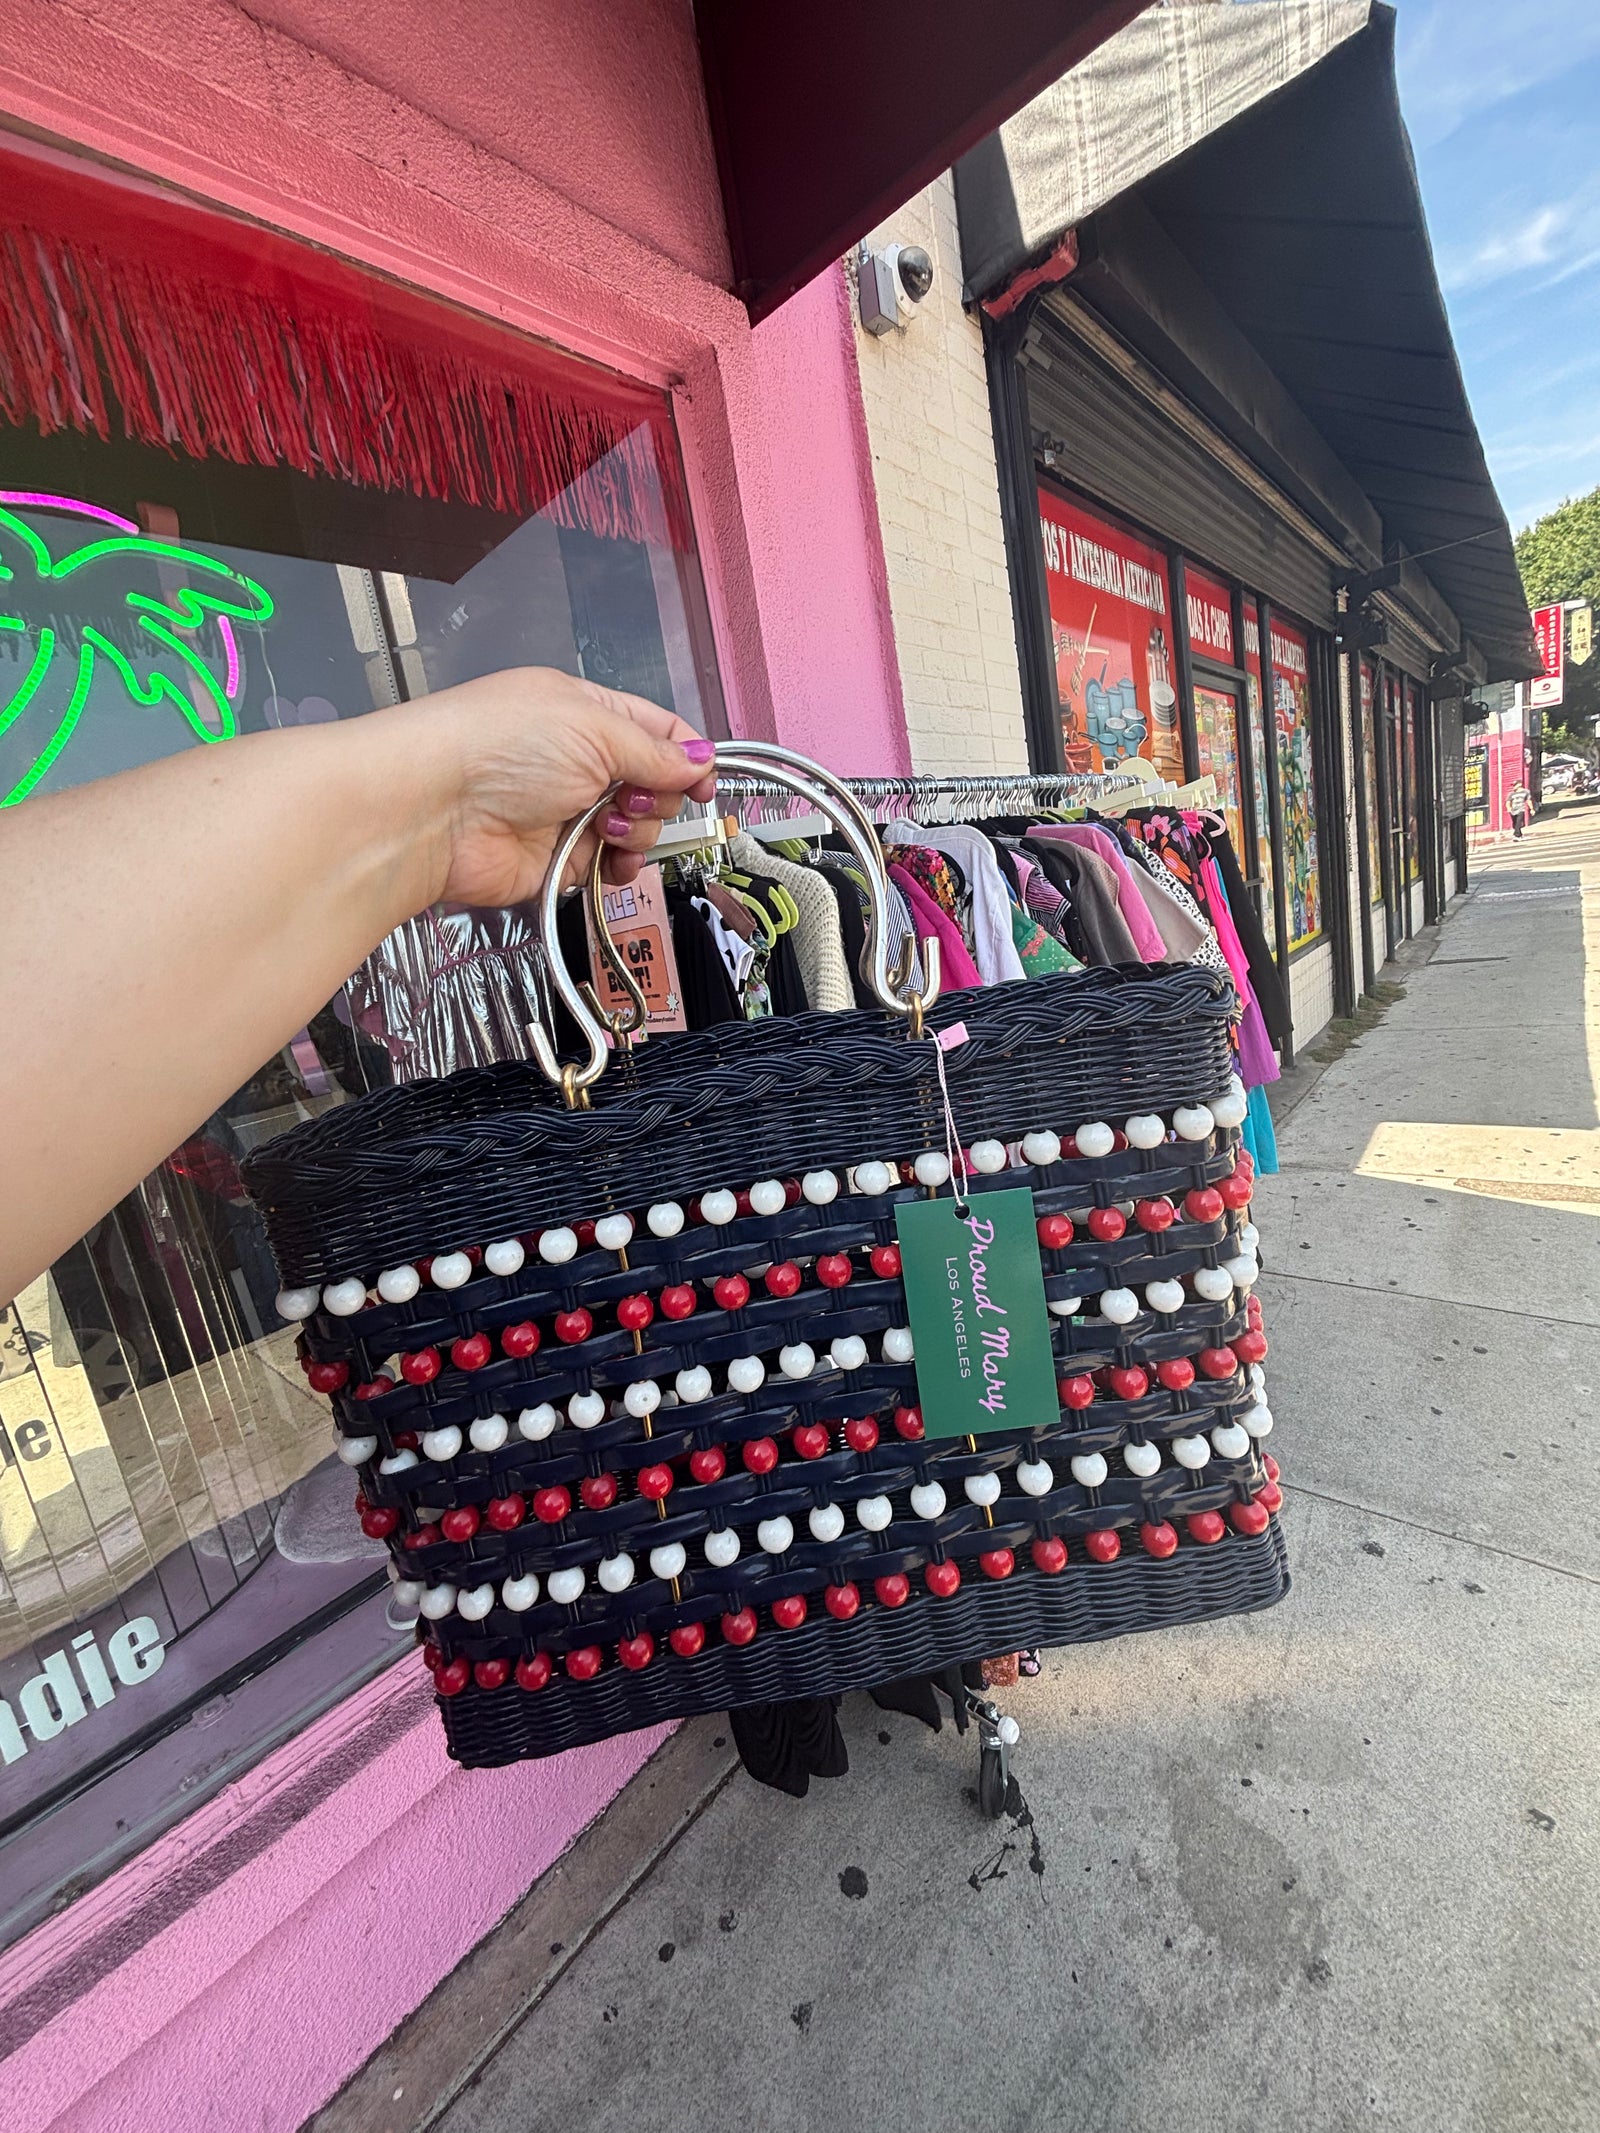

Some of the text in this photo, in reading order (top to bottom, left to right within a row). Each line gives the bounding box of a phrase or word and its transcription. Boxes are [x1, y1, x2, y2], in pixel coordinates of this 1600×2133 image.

[1058, 525, 1069, 576] Y
[1069, 530, 1124, 599] ARTESANIA
[1121, 556, 1166, 615] MEXICANA
[603, 886, 638, 923] ALE
[607, 966, 652, 993] BUT!
[627, 938, 654, 964] OR
[945, 1257, 971, 1379] LOS ANGELES
[963, 1216, 1010, 1415] Proud Mary
